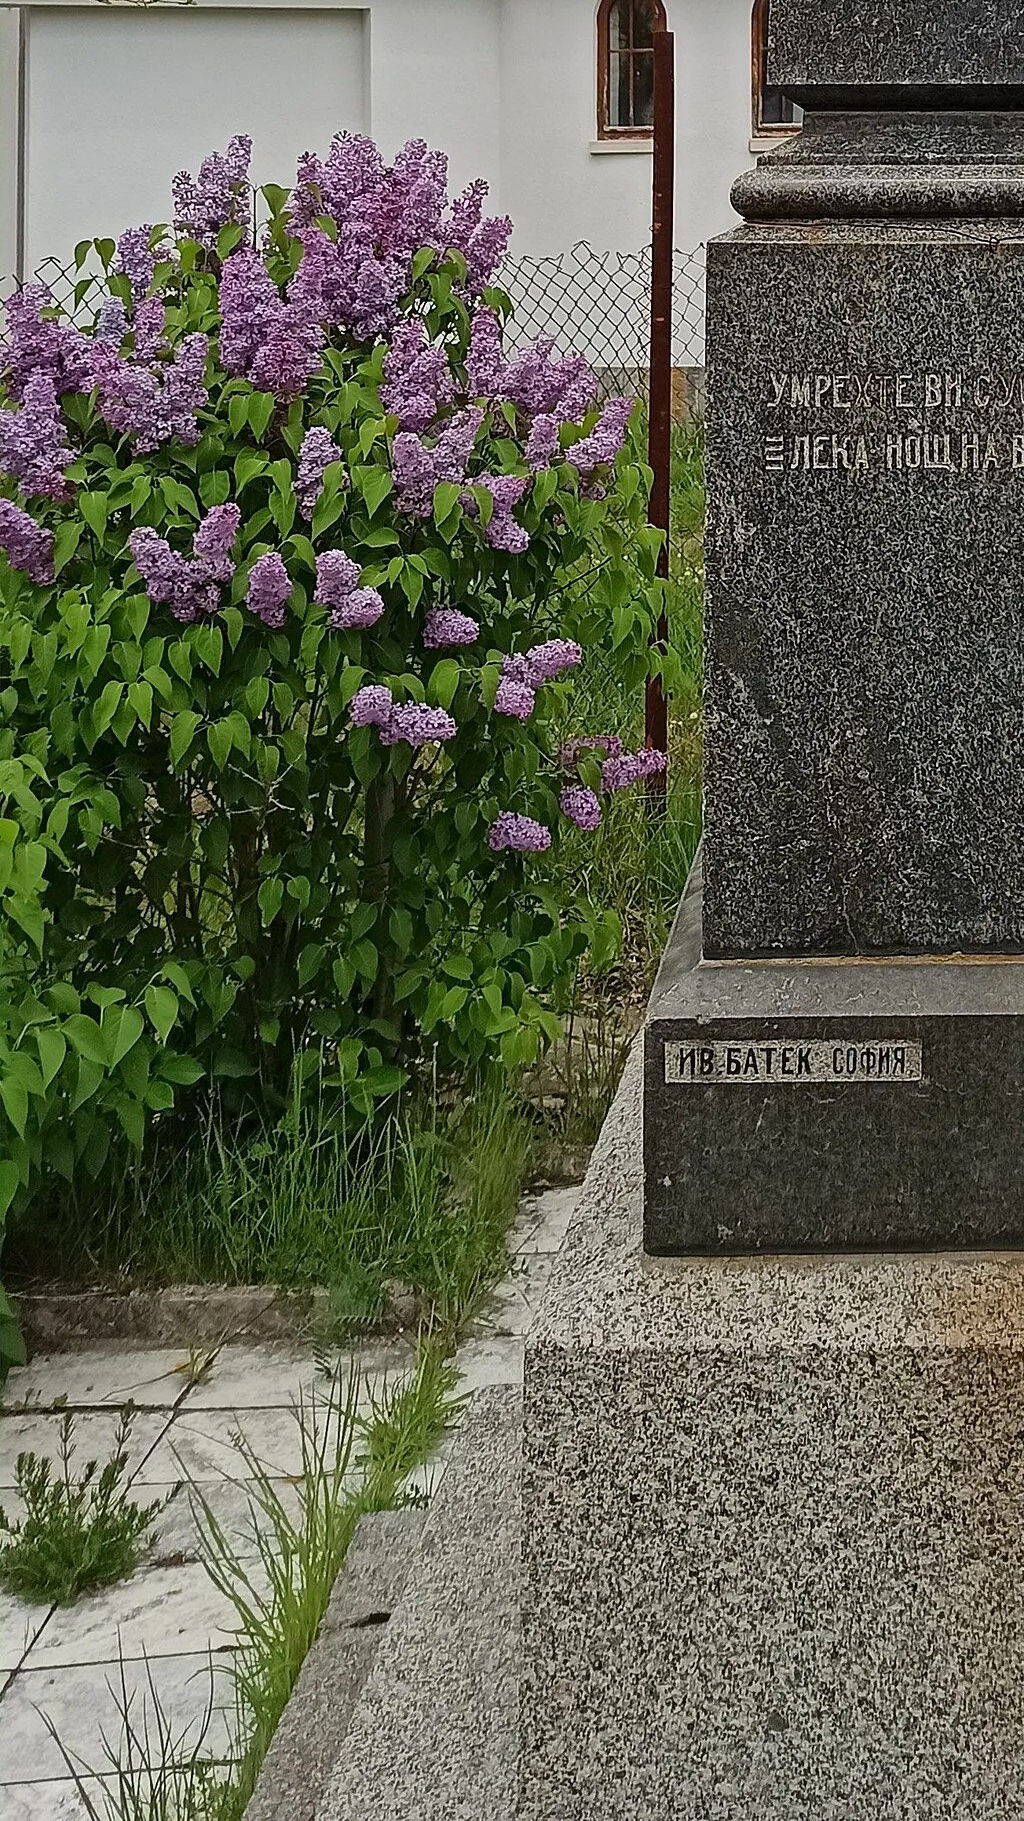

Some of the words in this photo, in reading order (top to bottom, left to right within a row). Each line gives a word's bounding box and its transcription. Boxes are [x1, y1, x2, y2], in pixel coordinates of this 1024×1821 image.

[767, 373, 914, 408] УМРЕХТЕ
[924, 373, 962, 407] ВИ
[973, 374, 991, 407] С
[790, 433, 869, 469] ЛЕКА
[886, 433, 957, 472] НОЩ
[832, 1047, 907, 1076] СОФИЯ
